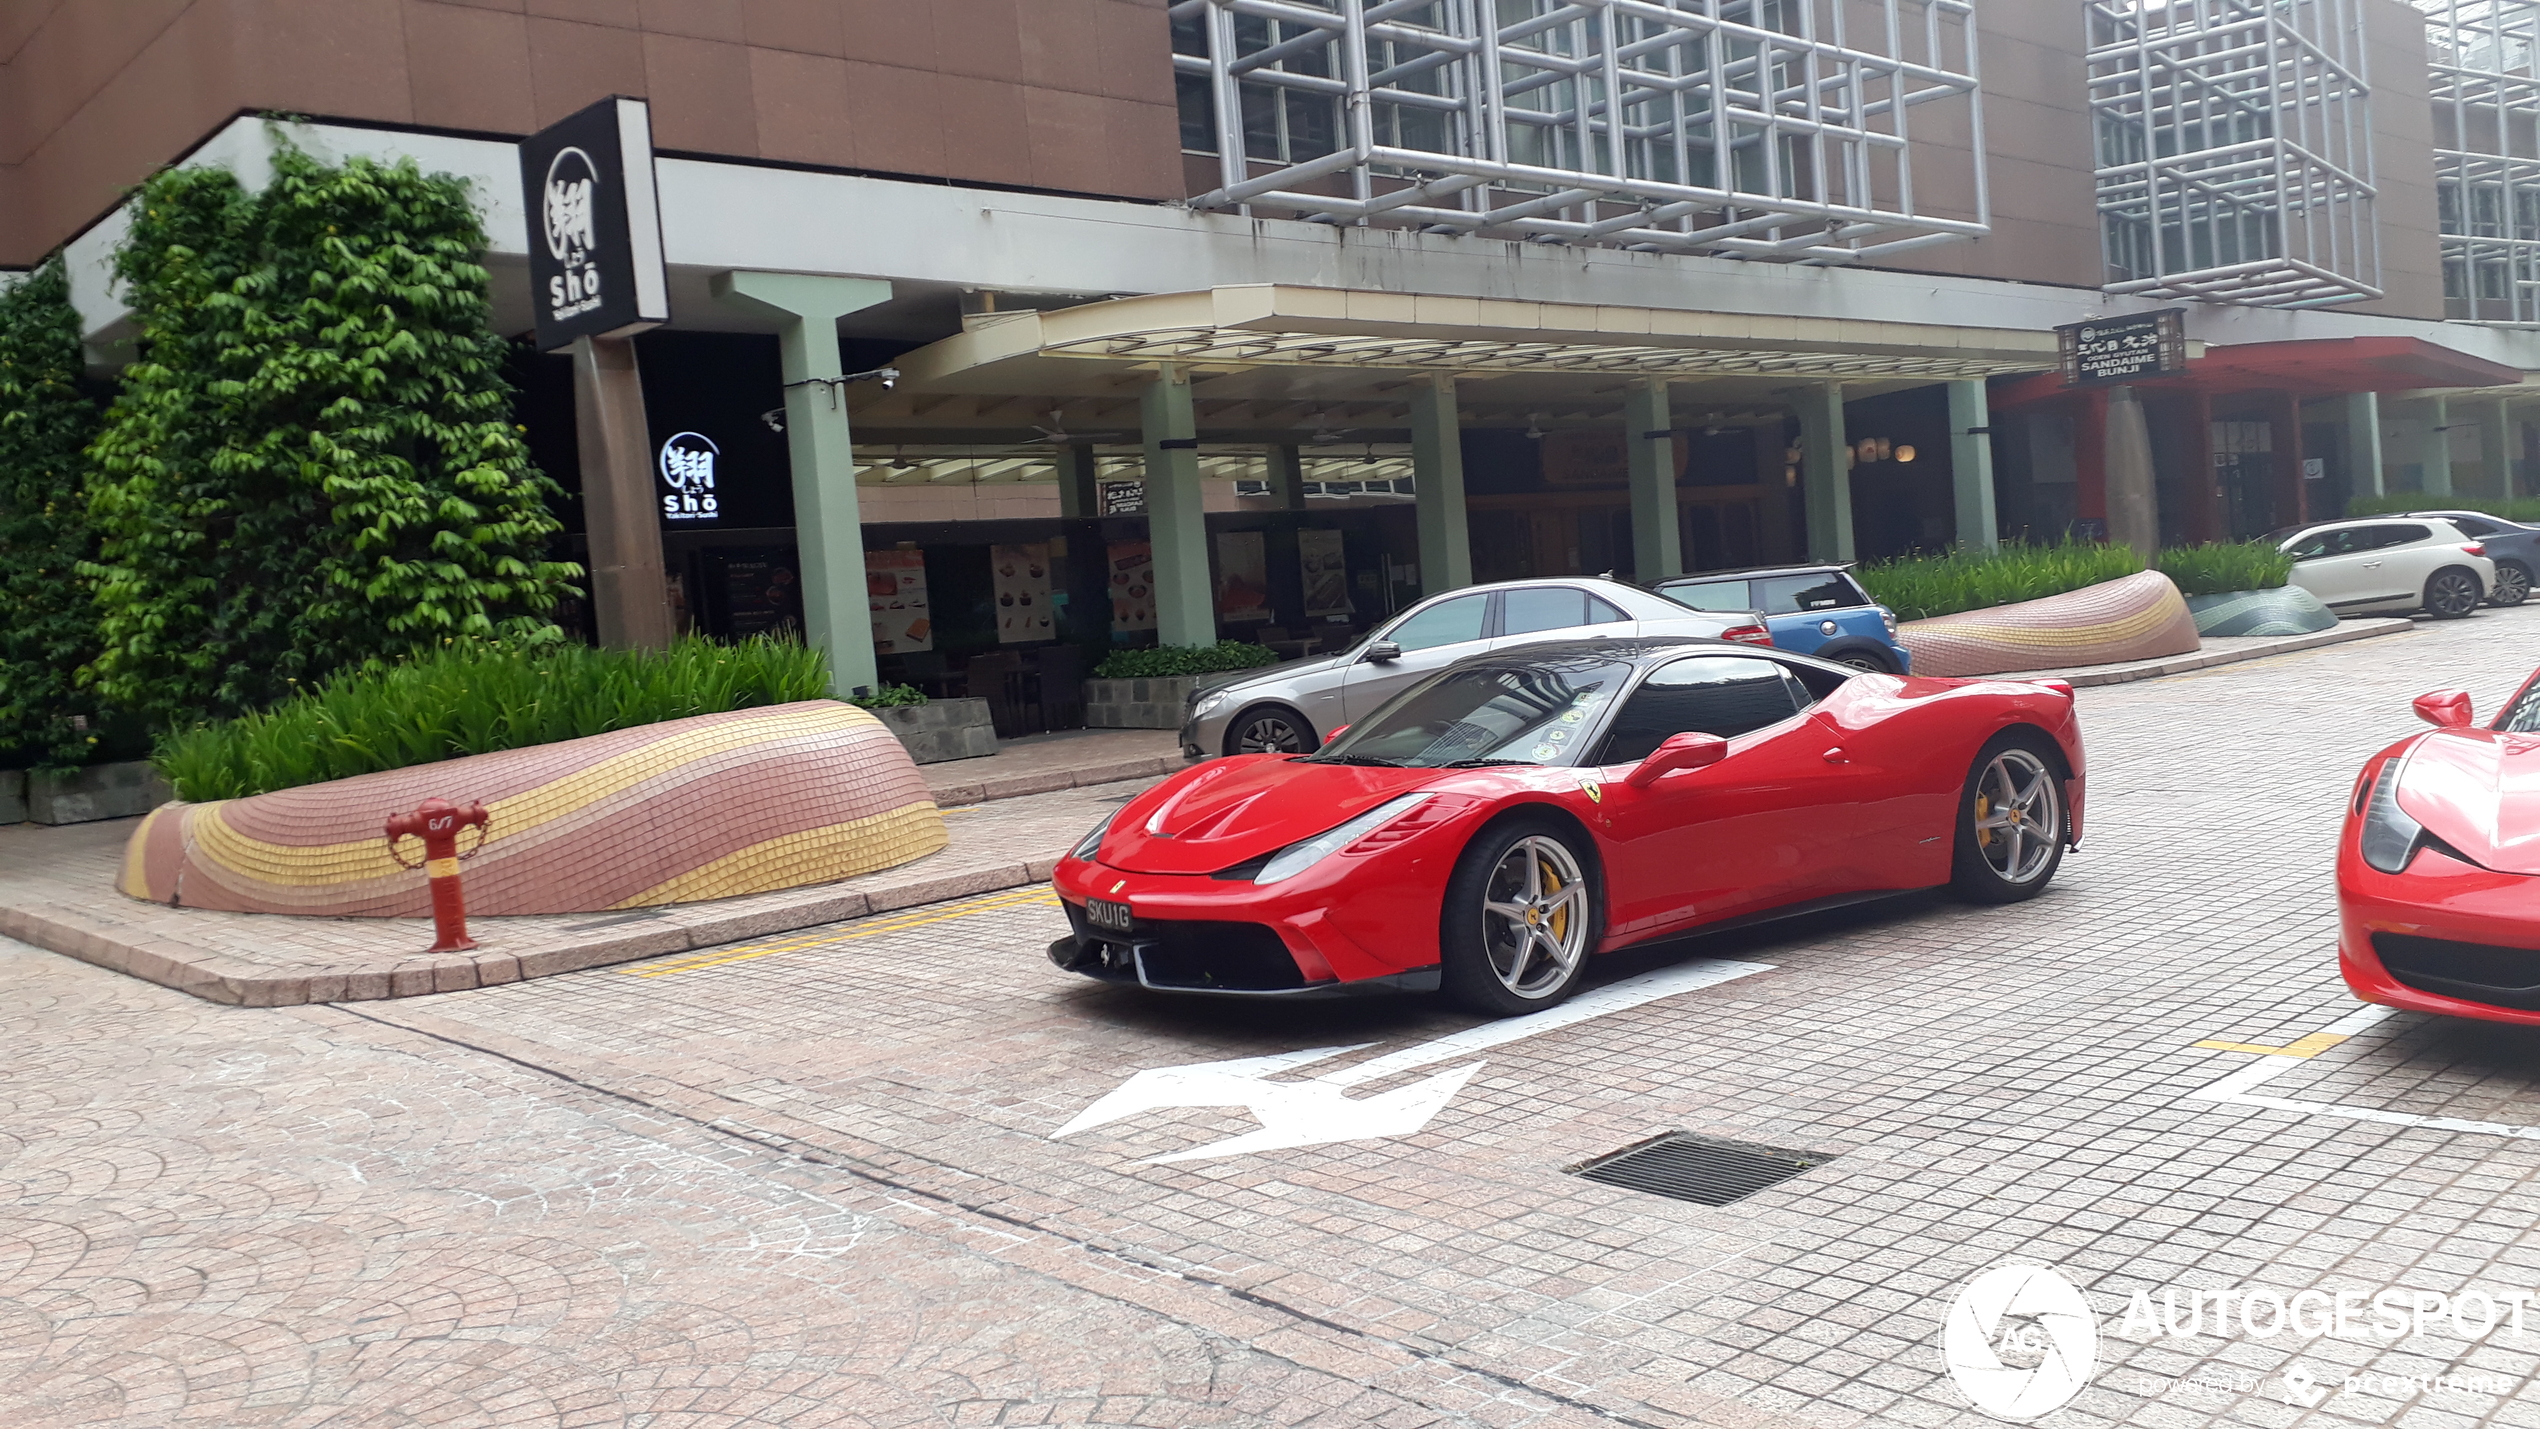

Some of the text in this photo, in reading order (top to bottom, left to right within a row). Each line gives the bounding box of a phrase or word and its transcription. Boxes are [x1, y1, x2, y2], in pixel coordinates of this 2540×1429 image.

[2113, 349, 2149, 358] GYUTAN
[2081, 354, 2156, 371] SANDAIME
[2097, 364, 2140, 377] BUNJI
[428, 816, 453, 830] 6/7
[1088, 900, 1130, 928] SKU1G
